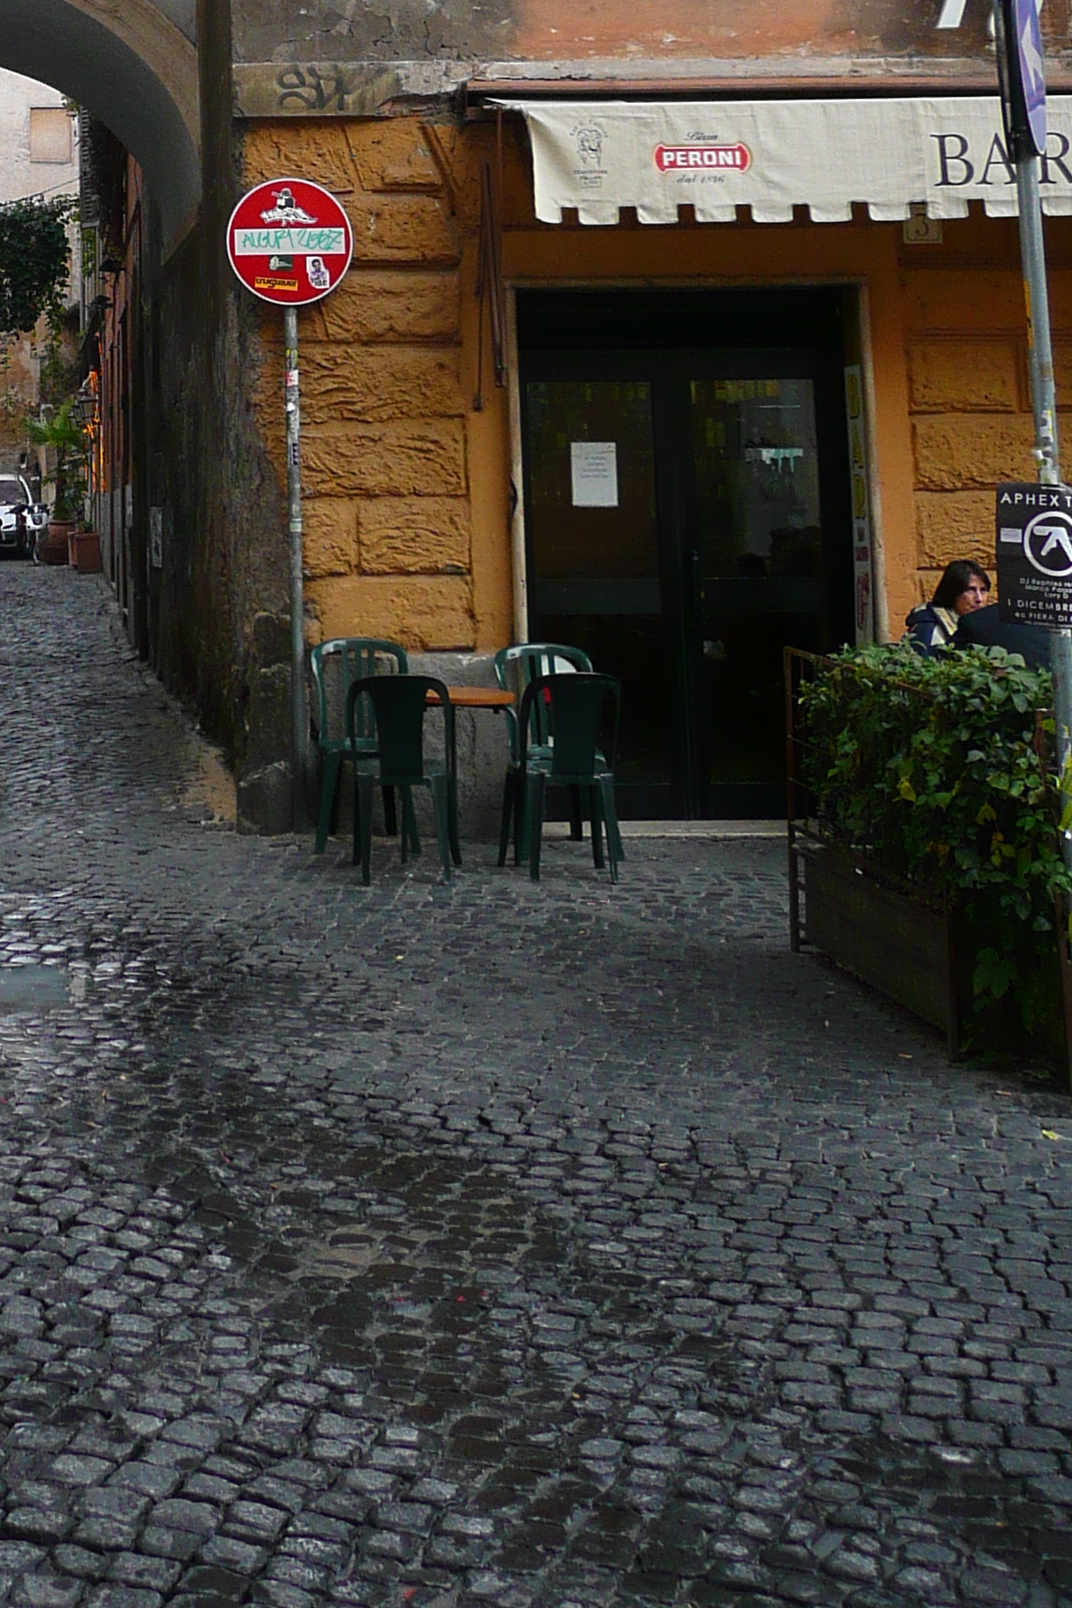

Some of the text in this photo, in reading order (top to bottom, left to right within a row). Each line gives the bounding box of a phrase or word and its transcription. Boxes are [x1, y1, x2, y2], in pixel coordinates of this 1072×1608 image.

[661, 150, 742, 167] PERONI
[930, 131, 1072, 188] BAR
[999, 492, 1060, 507] APHEX
[1029, 612, 1054, 621] FIERA
